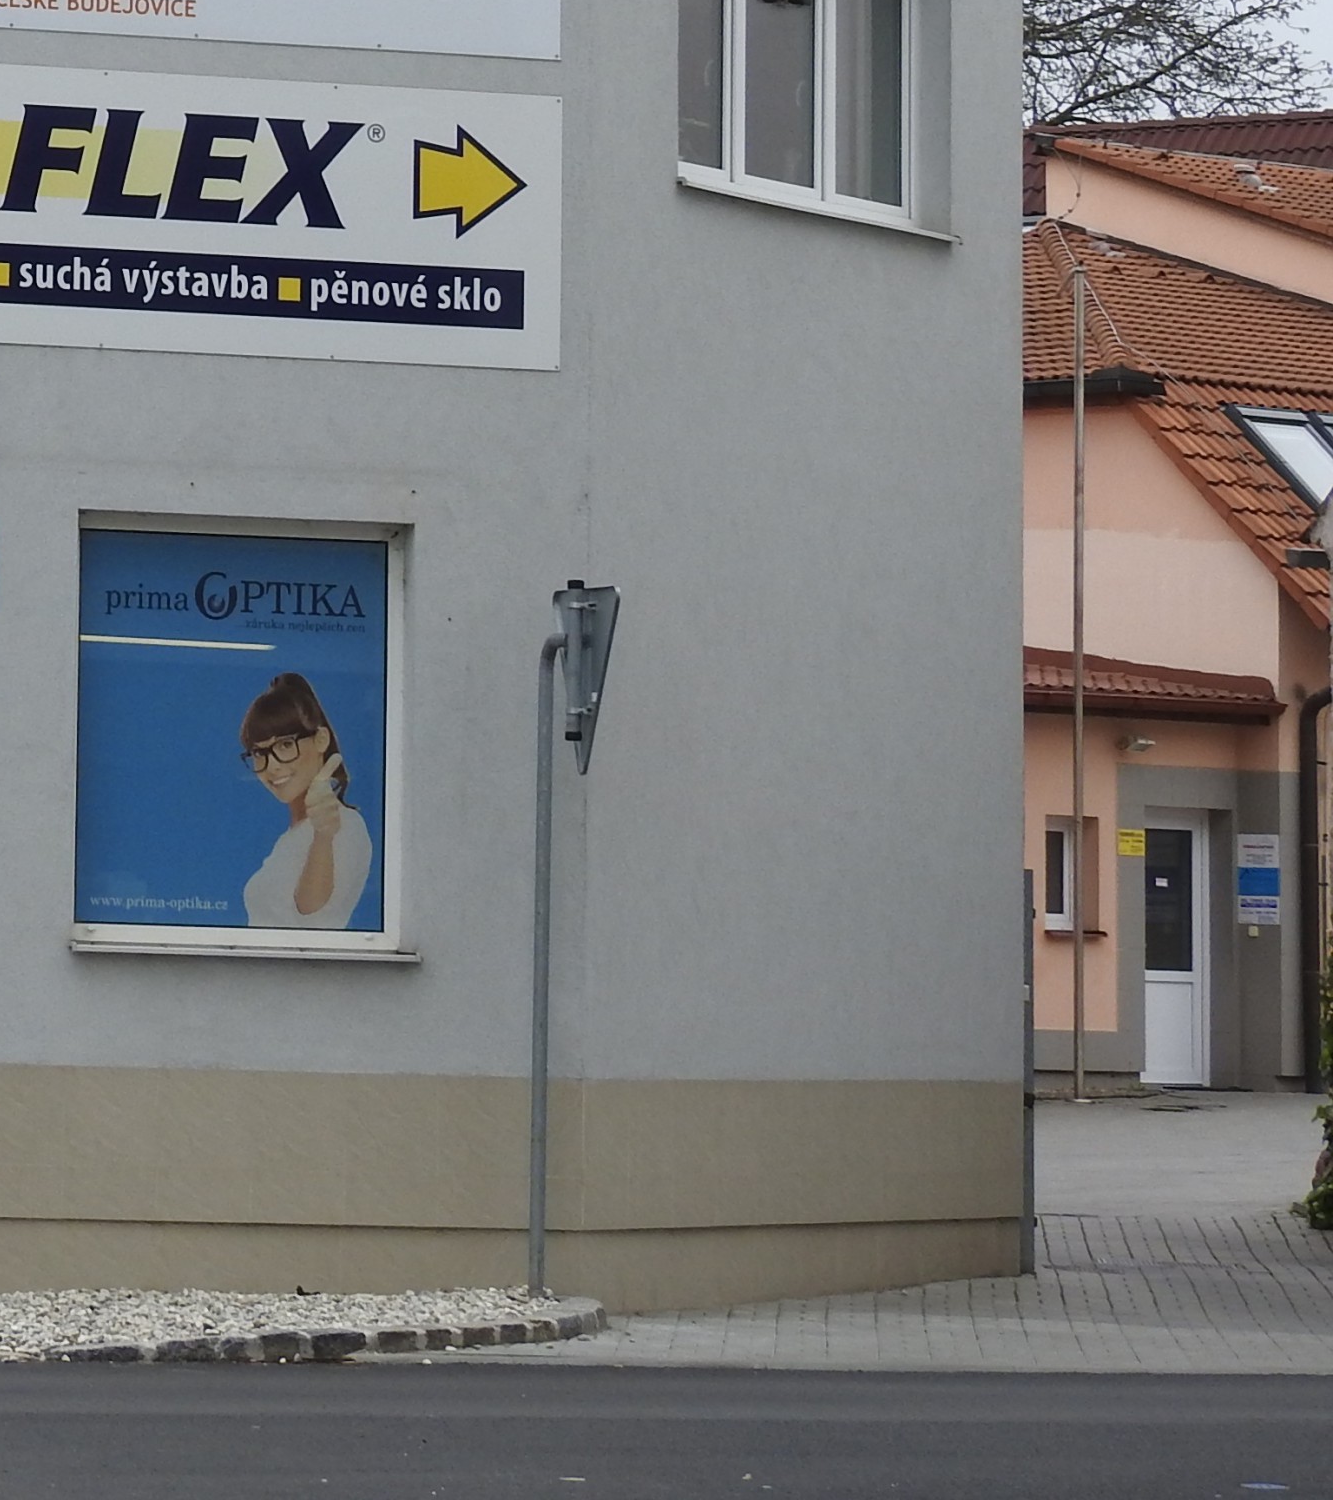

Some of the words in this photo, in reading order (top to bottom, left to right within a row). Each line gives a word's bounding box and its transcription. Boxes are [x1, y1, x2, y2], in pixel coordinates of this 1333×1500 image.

[18, 256, 112, 292] suchá
[122, 260, 268, 303] výstavba
[310, 270, 428, 312] pěnové
[437, 275, 502, 312] sklo
[105, 583, 190, 617] prima
[194, 571, 366, 620] OPTIKA
[89, 894, 229, 912] www.prima-optika.cz
